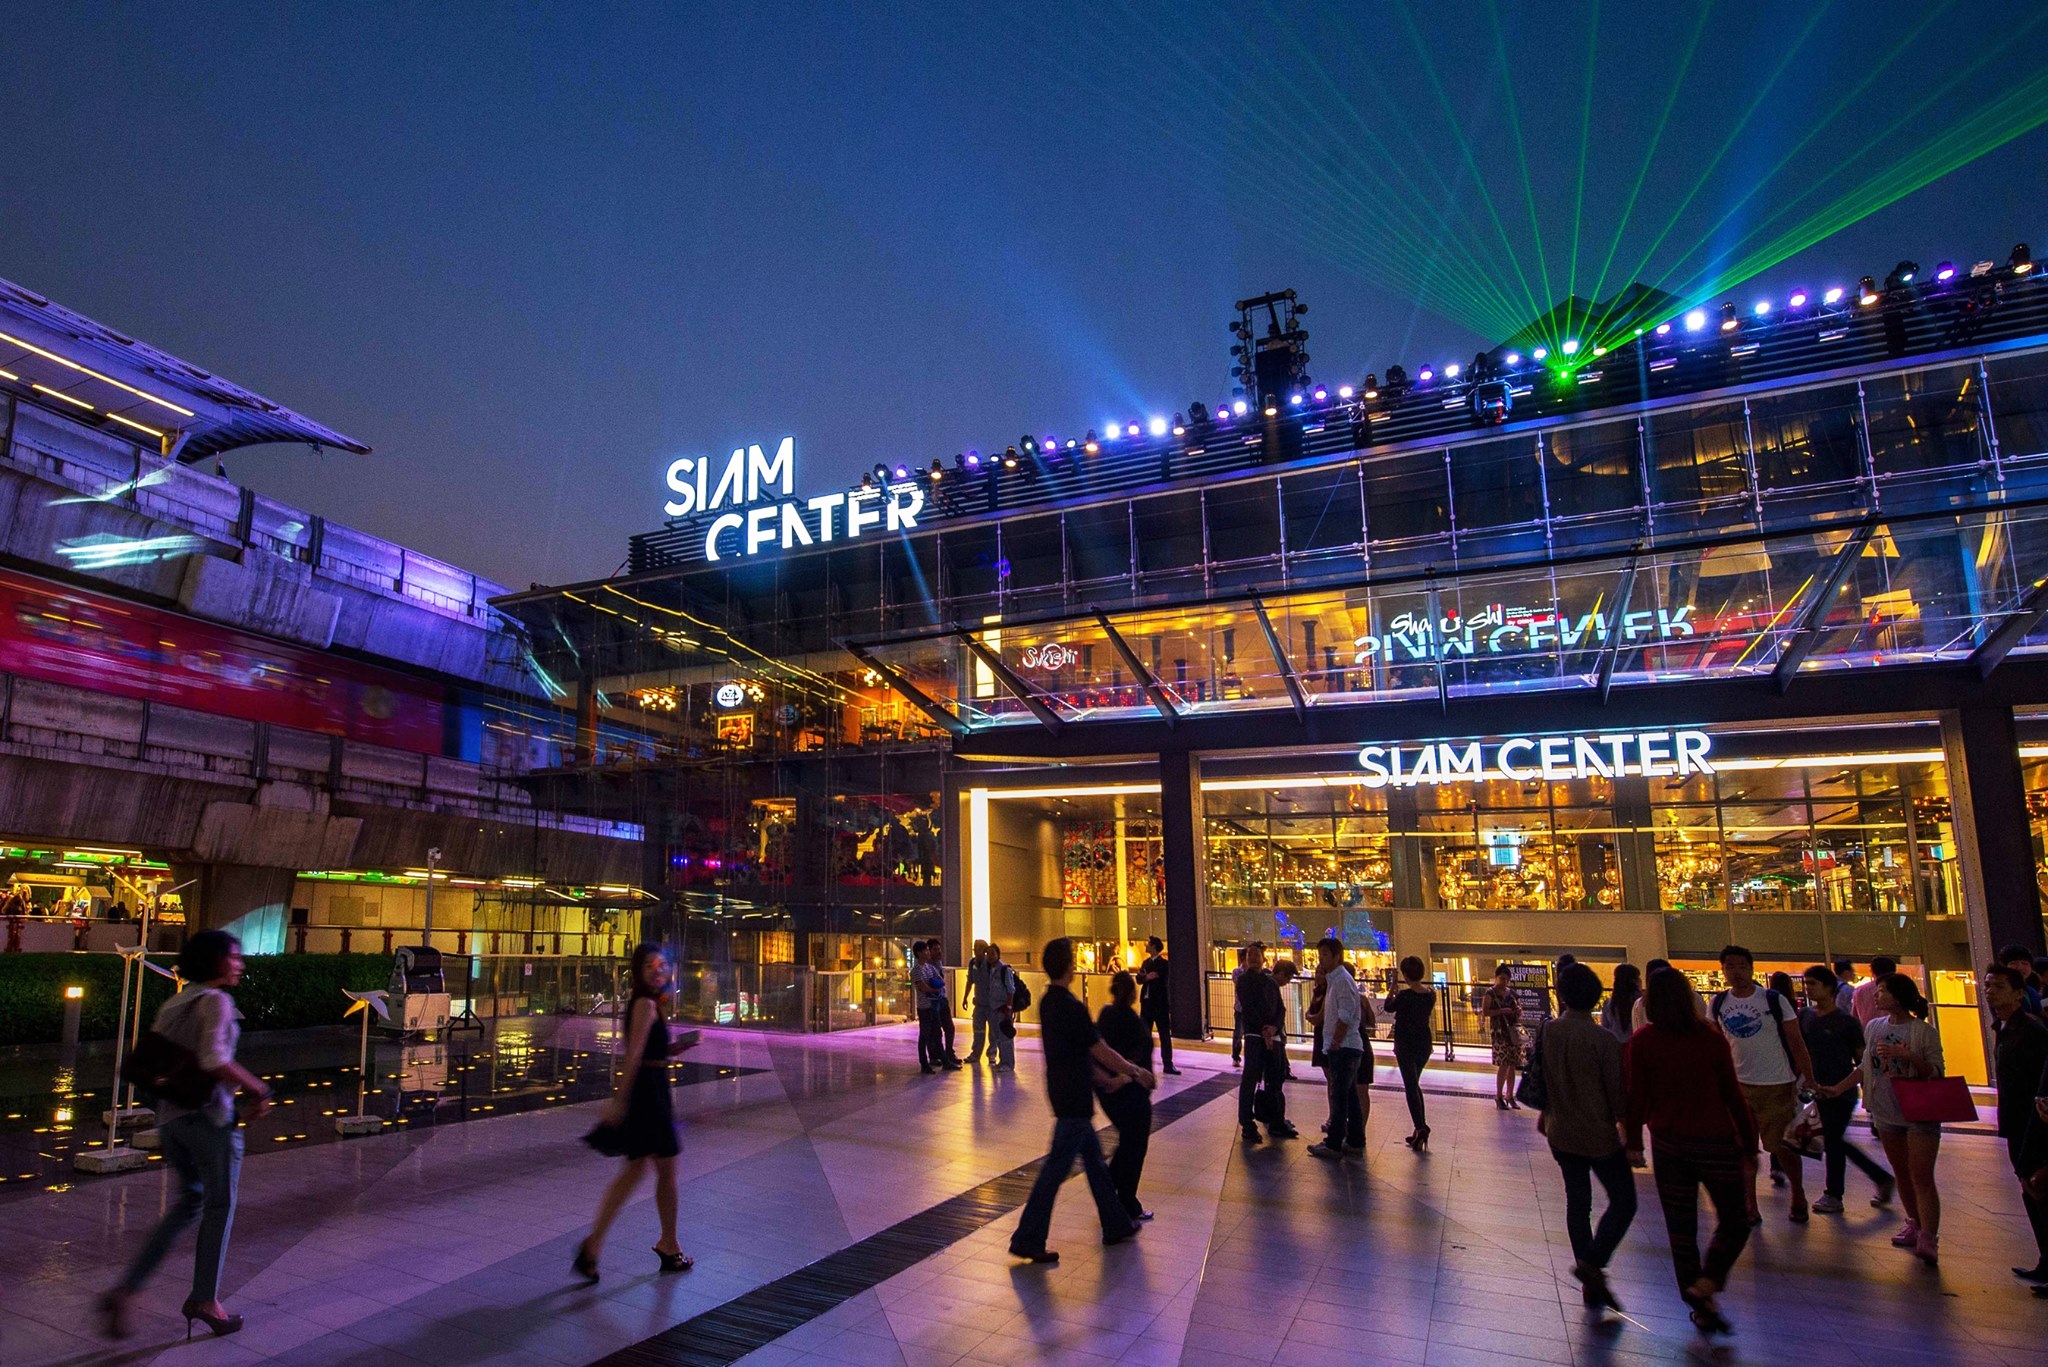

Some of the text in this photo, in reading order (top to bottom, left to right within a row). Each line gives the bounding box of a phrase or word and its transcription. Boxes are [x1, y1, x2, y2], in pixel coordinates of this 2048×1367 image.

[663, 436, 795, 517] SIAM
[704, 482, 925, 562] CENTER
[1358, 730, 1717, 789] SIAM CENTER
[1723, 1004, 1761, 1019] HOLLISTER
